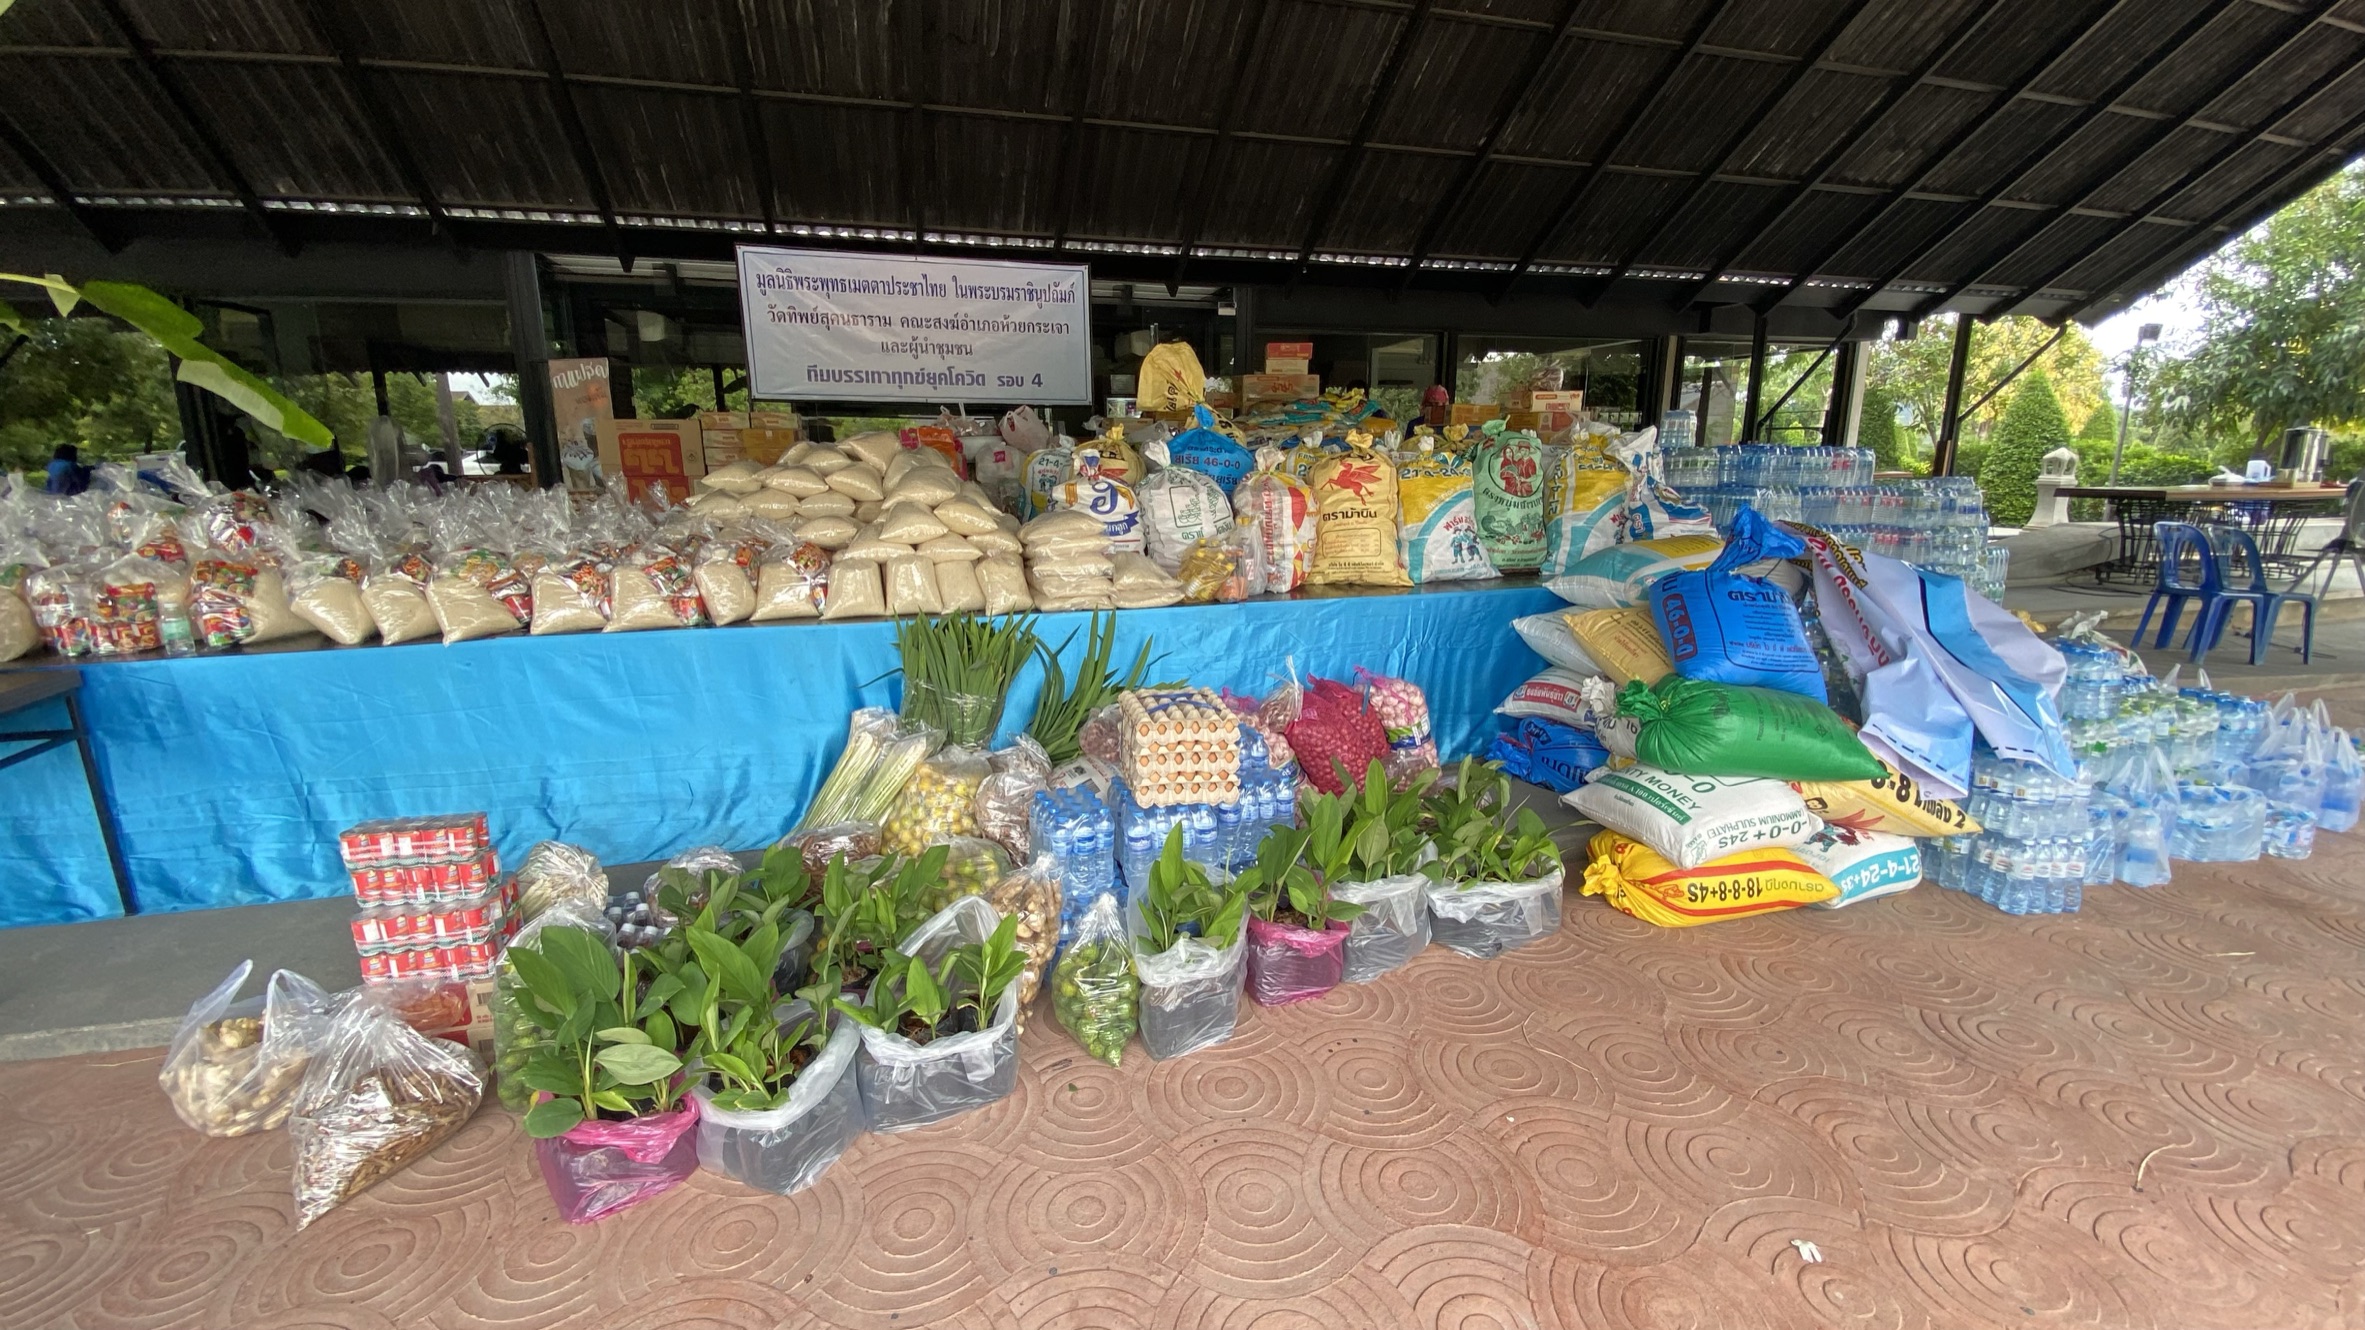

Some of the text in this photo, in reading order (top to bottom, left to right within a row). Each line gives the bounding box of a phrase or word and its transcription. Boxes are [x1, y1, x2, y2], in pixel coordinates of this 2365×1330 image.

[756, 267, 1075, 309] มูลนิธิพระพุทธเมตตาประชาไทย ในพระบรมราชินูปถัมภ์
[767, 304, 1070, 335] วัดทิพย์สุคนธาราม คณะสงฆ์อำเภอห้วยกระเจา
[881, 336, 973, 360] และผู้นำชุมชน
[807, 364, 1044, 390] ทีมบรรเทาทุกข์ยุคโควิด รอบ 4
[1203, 456, 1241, 470] 46-0-0
[1323, 507, 1377, 522] ตราม้าบิน
[1645, 775, 1702, 810] MONEY
[1706, 813, 1757, 839] SULPHATE)
[1953, 810, 1966, 829] 2
[1718, 830, 1749, 849] 24S
[1687, 876, 1763, 903] 18-8-8+4S
